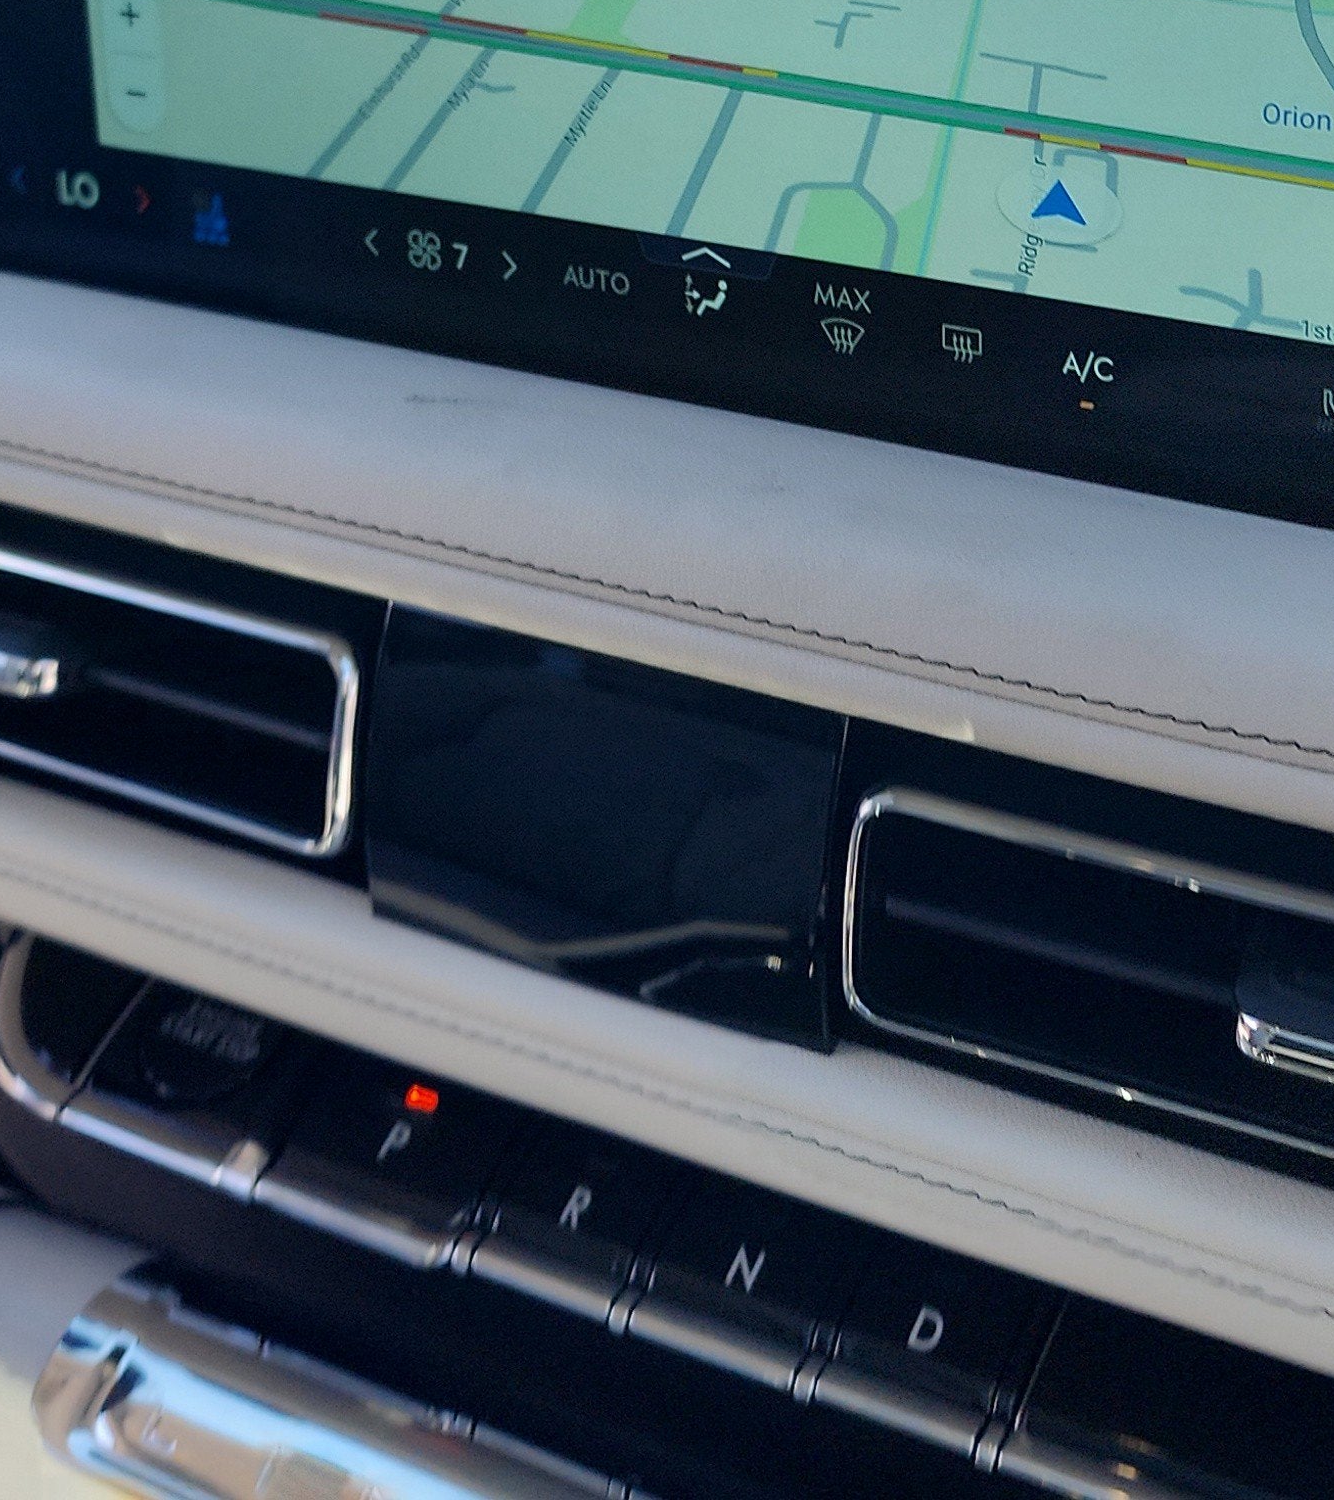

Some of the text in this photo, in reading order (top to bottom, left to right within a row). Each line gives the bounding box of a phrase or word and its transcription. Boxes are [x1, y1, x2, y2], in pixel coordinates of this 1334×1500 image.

[564, 80, 612, 147] Myrtle Ln
[1262, 102, 1332, 133] Orion
[56, 168, 100, 210] LO
[452, 243, 468, 269] 7
[563, 264, 631, 296] AUTO
[813, 282, 872, 314] MAX
[1300, 319, 1333, 341] 1st
[1062, 351, 1114, 383] A/C
[377, 1120, 411, 1163] P
[559, 1185, 592, 1232] R
[723, 1242, 766, 1292] N
[907, 1304, 947, 1352] D
